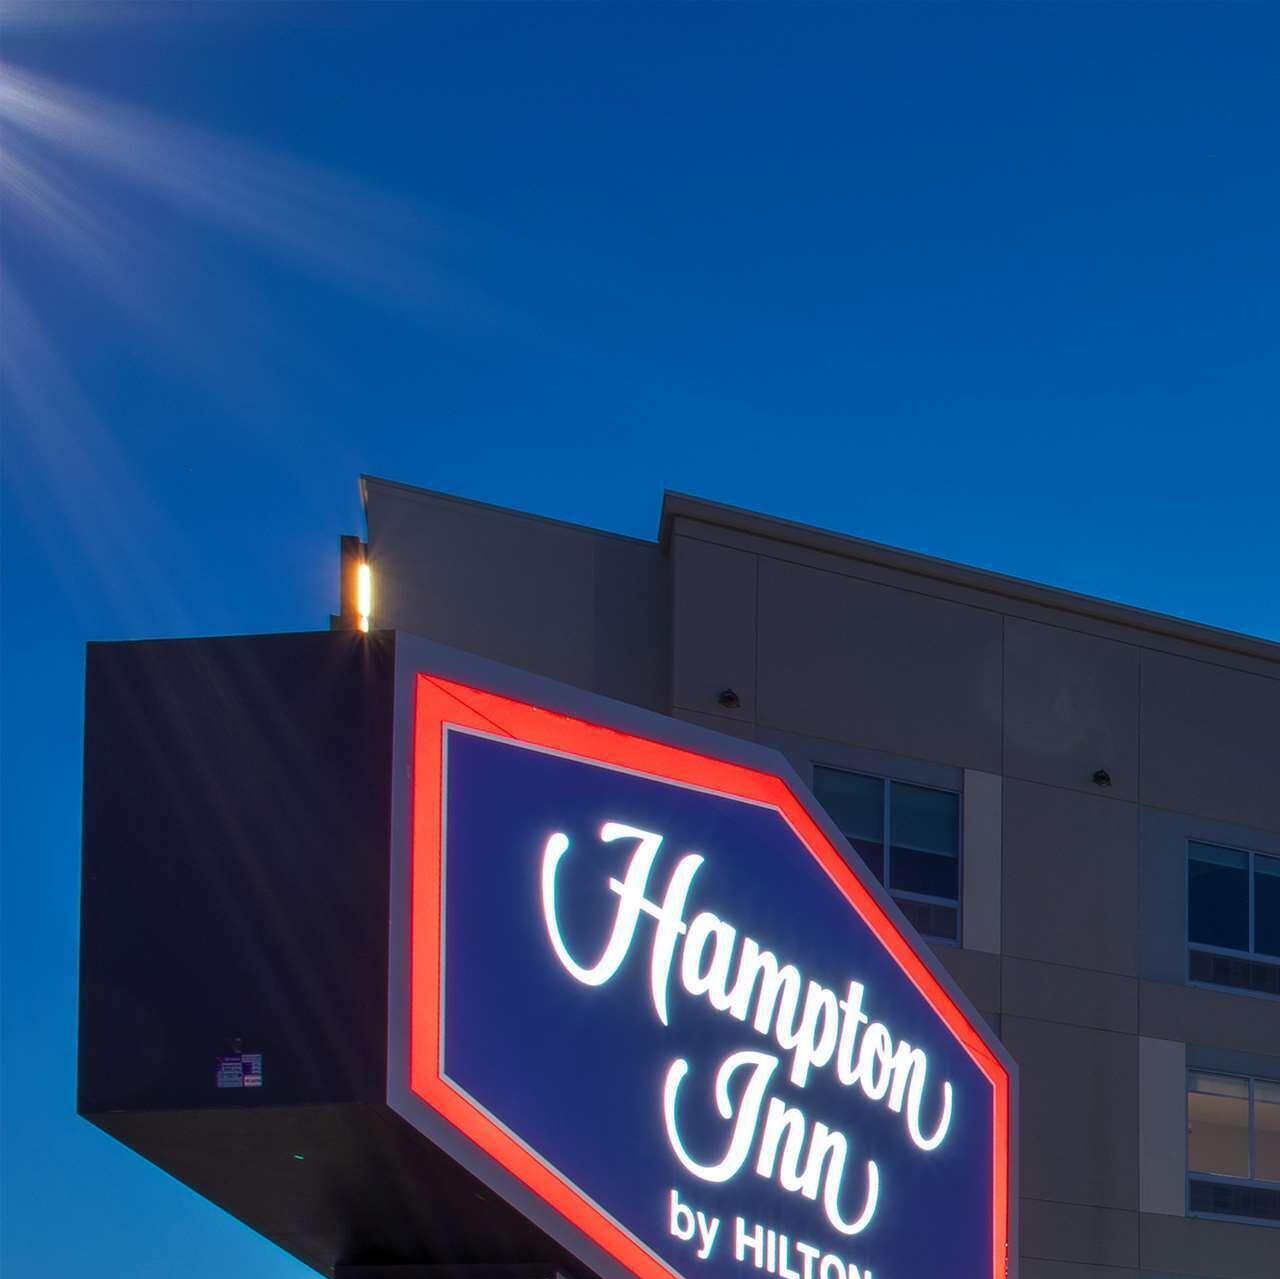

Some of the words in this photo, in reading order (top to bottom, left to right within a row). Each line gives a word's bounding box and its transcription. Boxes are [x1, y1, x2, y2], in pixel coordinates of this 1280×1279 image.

[543, 822, 952, 1151] Hampton
[664, 1051, 880, 1236] Inn
[670, 1188, 721, 1260] by
